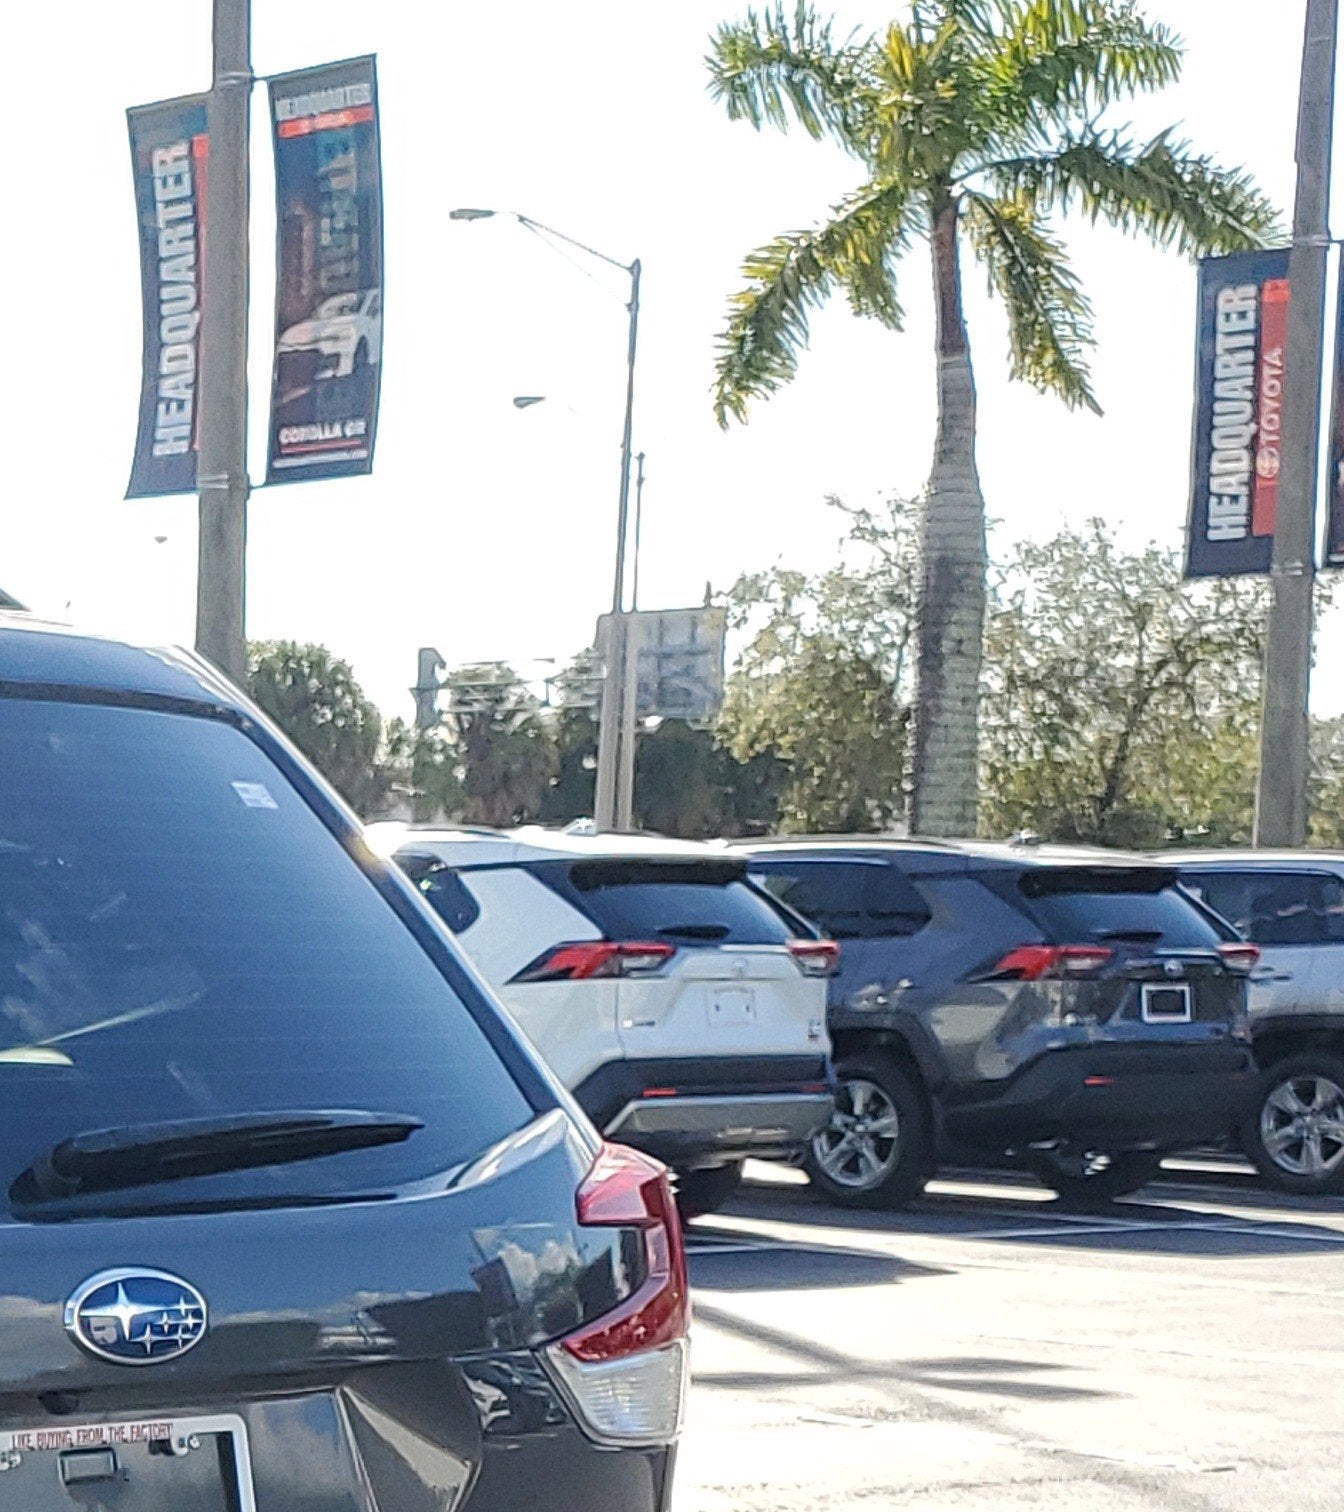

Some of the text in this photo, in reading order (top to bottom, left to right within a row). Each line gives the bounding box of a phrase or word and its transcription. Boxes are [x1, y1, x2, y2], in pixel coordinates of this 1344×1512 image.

[151, 138, 201, 458] HEADQUARTER
[1206, 282, 1258, 542] HEADQUARTER
[1259, 346, 1283, 447] TOYOTA
[76, 1427, 106, 1445] FROM
[108, 1425, 126, 1443] THE
[129, 1422, 174, 1442] FACTORY
